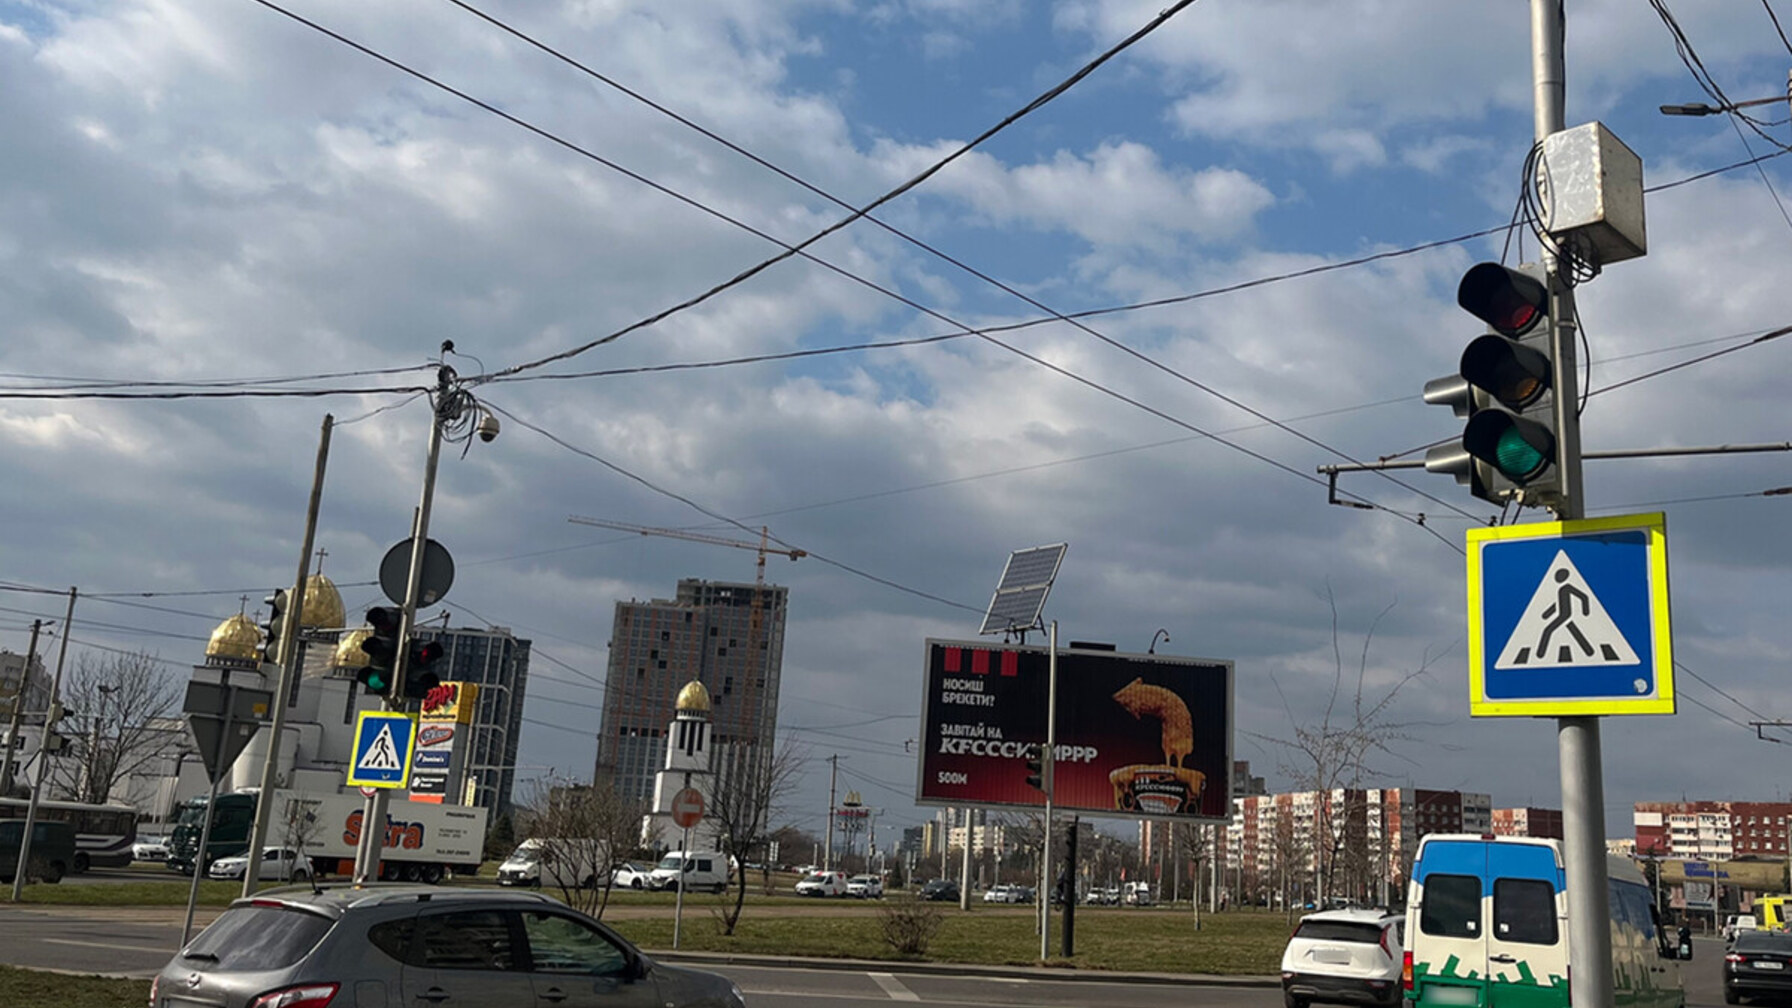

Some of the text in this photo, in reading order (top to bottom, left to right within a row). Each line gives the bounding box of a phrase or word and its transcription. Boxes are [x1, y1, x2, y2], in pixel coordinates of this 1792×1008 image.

[943, 678, 984, 692] НОСИШ
[942, 691, 996, 707] БРЕКЕТИ?
[940, 722, 1003, 739] ЗАВІТАЙ НА
[937, 771, 968, 785] 500М
